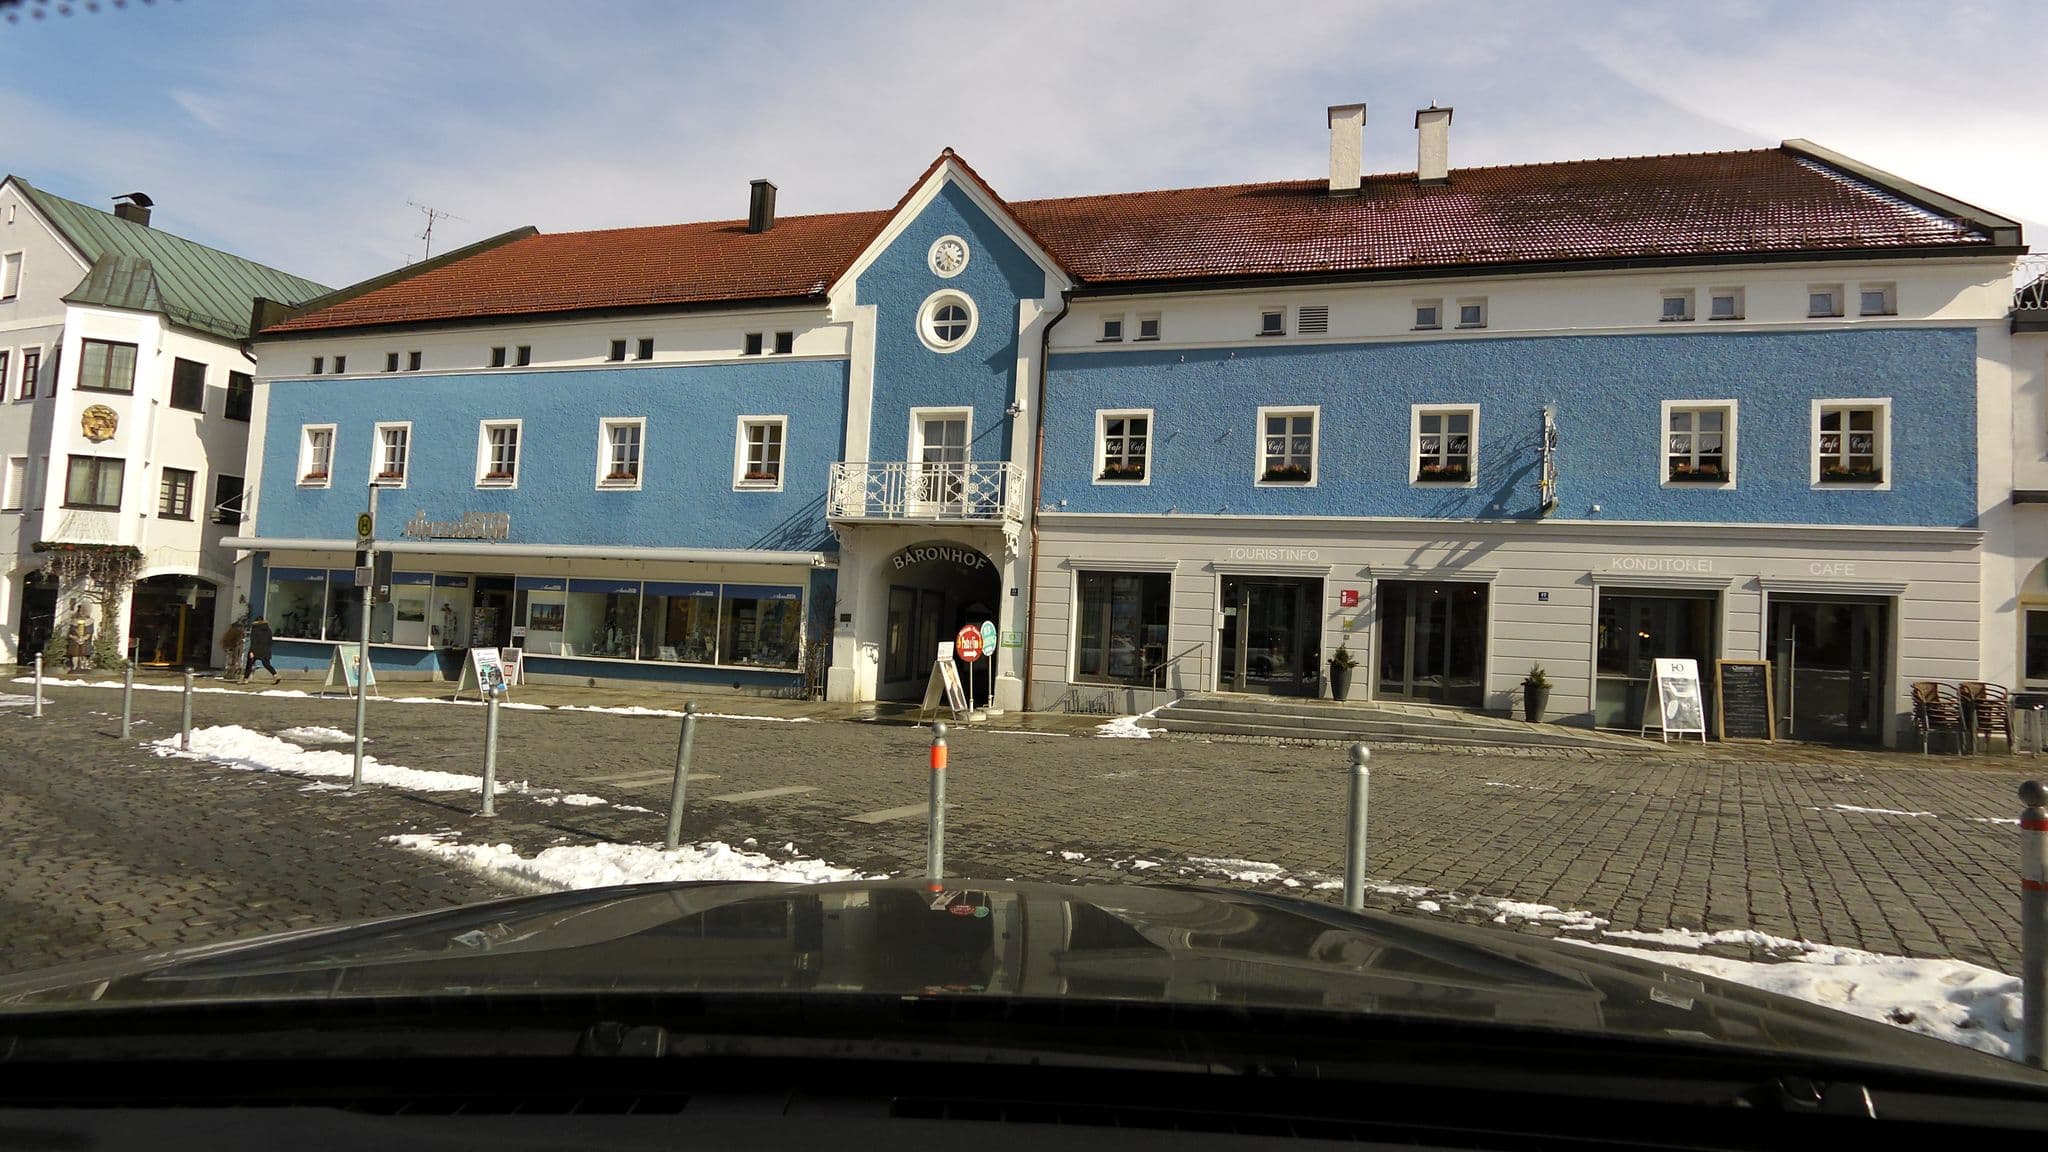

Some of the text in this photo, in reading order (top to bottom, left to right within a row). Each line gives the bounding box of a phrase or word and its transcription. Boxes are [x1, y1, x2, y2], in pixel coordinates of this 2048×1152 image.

[892, 547, 987, 569] BARONHOF
[1227, 548, 1319, 561] TOURISTINFO
[1612, 557, 1713, 572] KONDITOREI
